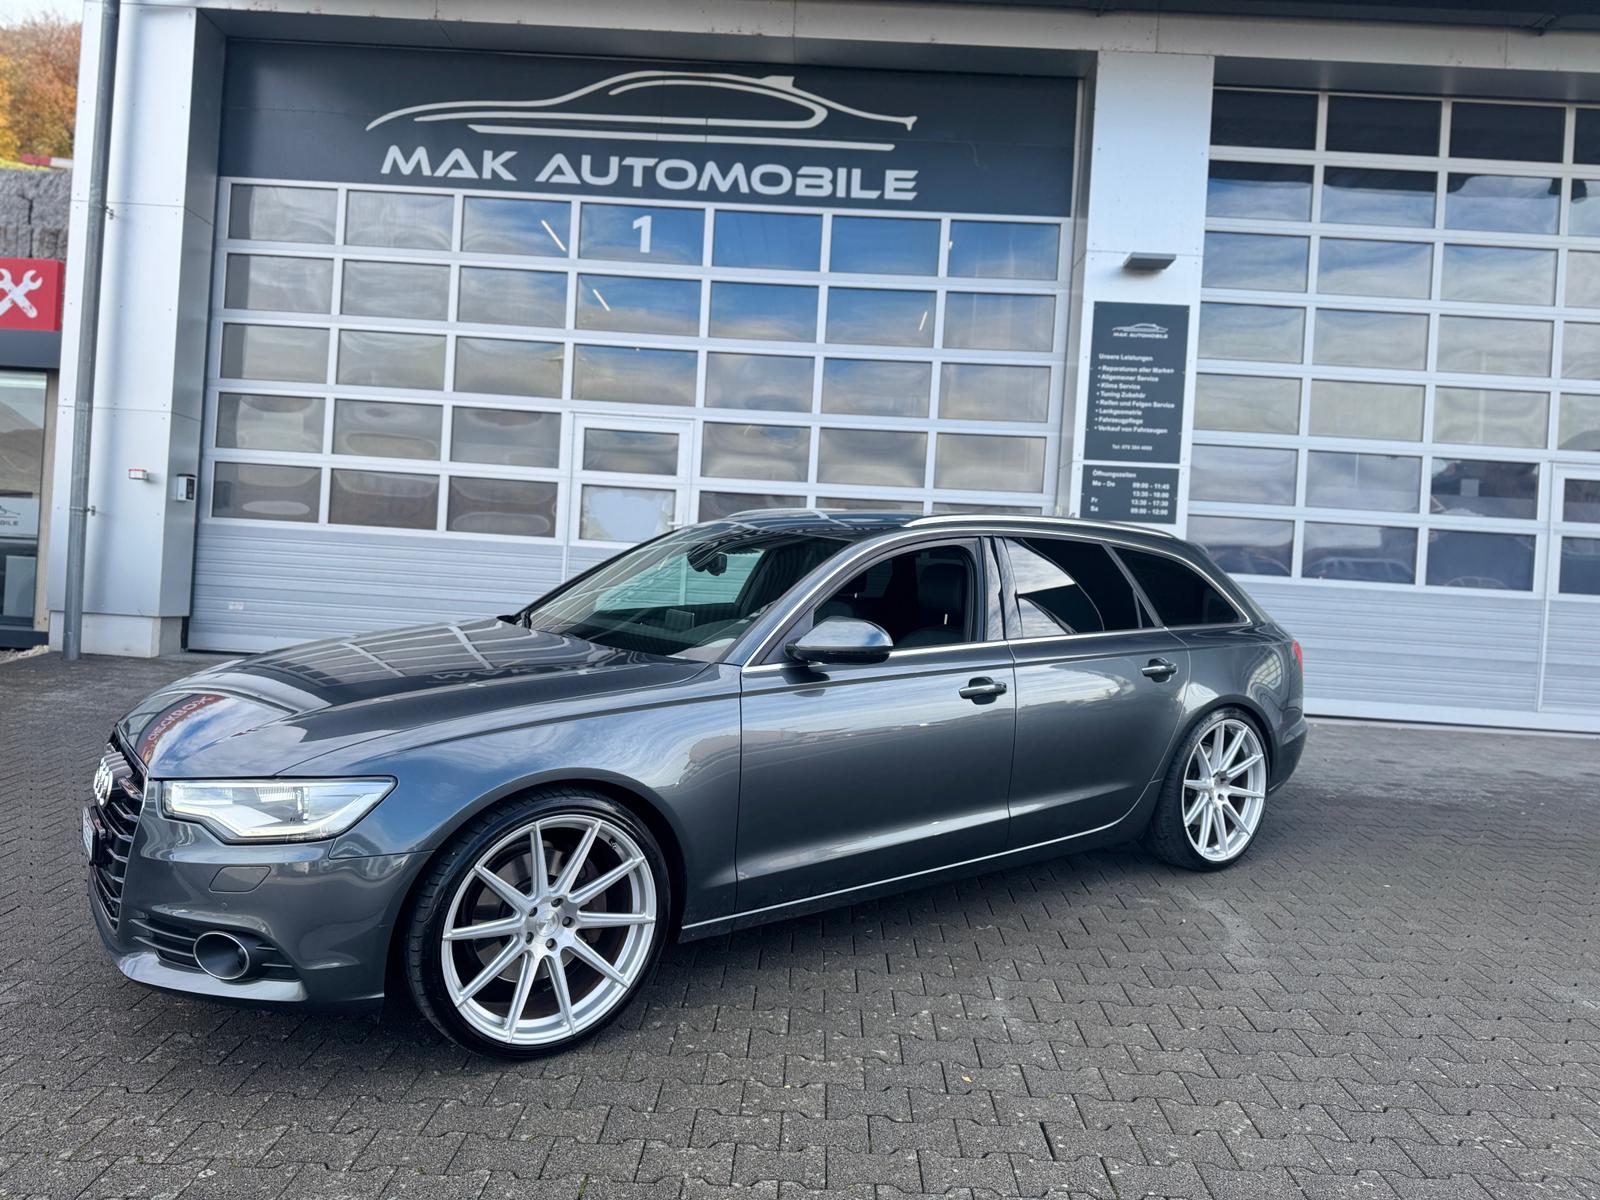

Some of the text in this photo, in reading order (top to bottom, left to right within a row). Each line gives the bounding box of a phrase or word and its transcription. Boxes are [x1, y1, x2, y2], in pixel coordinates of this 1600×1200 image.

[381, 145, 919, 201] MAK AUTOMOBILE
[632, 215, 652, 254] 1
[1120, 354, 1153, 362] Leistungen
[1102, 365, 1138, 373] Reparaturen
[1100, 390, 1120, 399] Tuning
[1132, 400, 1152, 408] Felgen
[1133, 426, 1168, 435] Fahrzeugen
[1092, 469, 1137, 479] Öffnungszeiten
